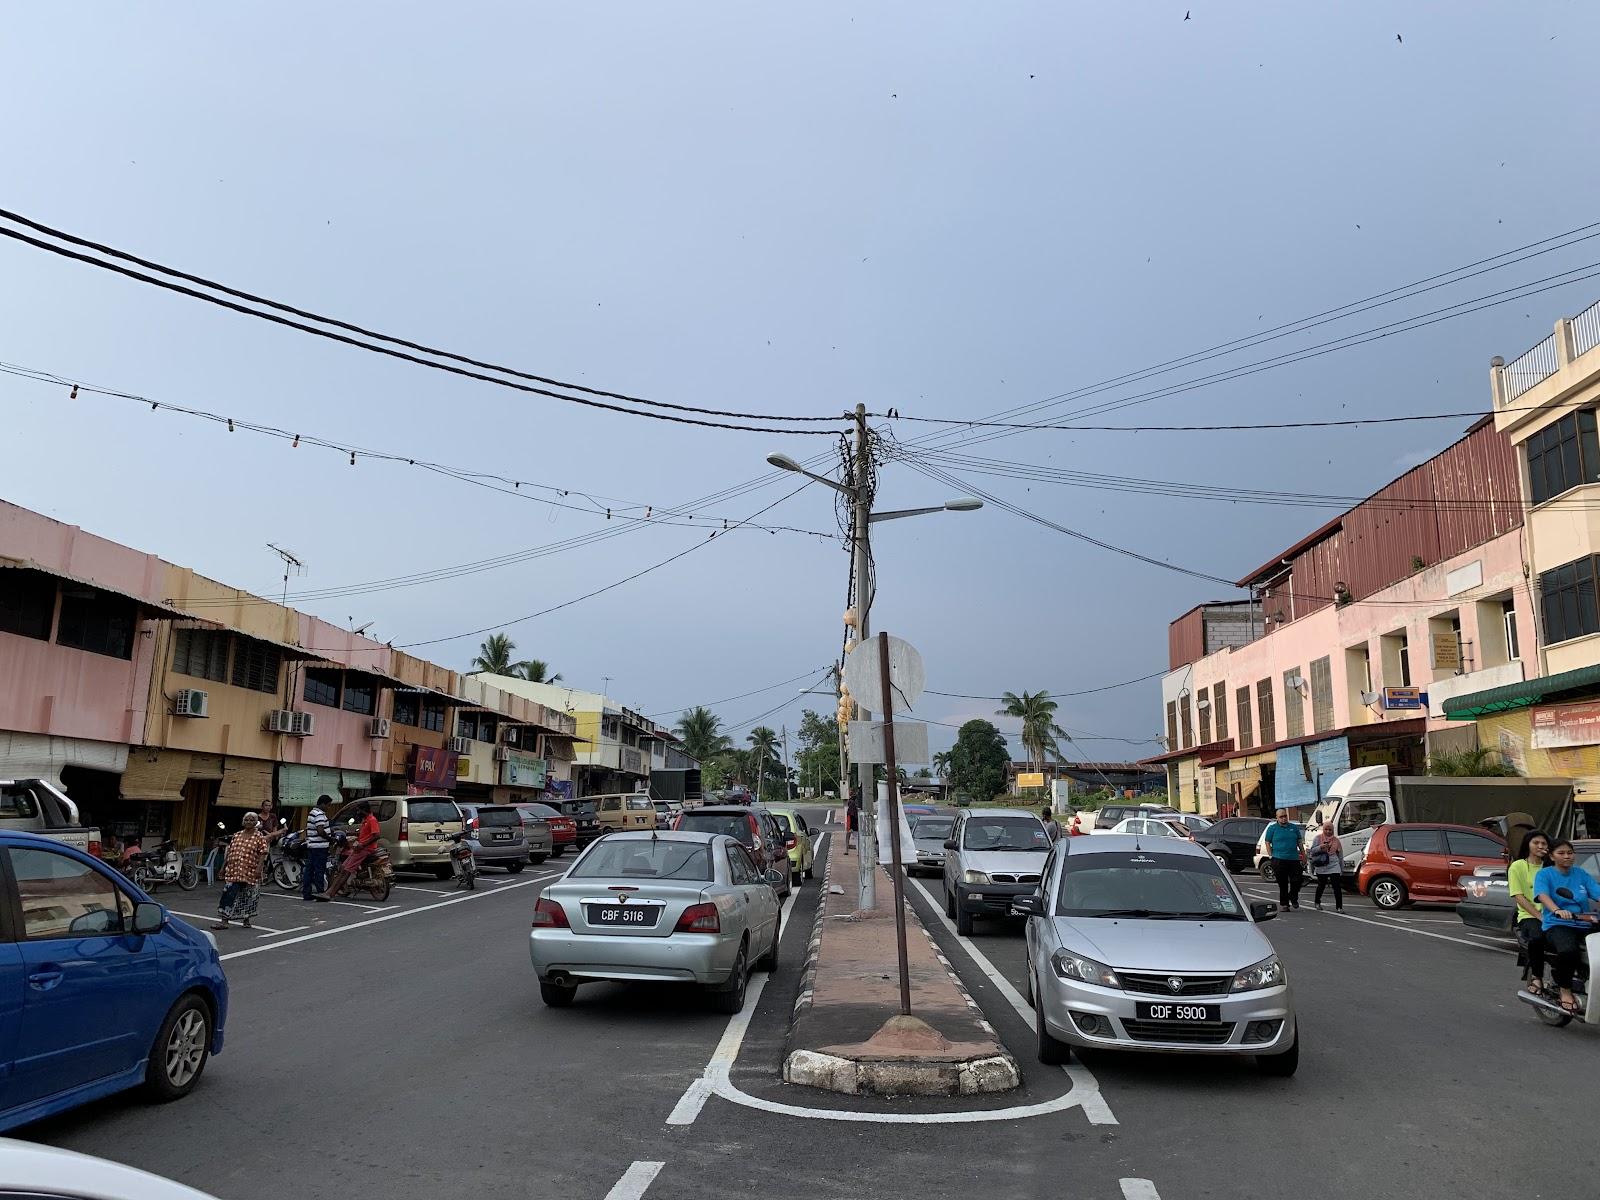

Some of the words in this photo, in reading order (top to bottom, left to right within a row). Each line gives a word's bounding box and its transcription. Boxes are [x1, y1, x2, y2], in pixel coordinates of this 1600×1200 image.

[601, 909, 620, 921] CBF
[622, 910, 644, 922] 5116
[1150, 1004, 1173, 1019] CDF
[1176, 1005, 1207, 1020] 5900
